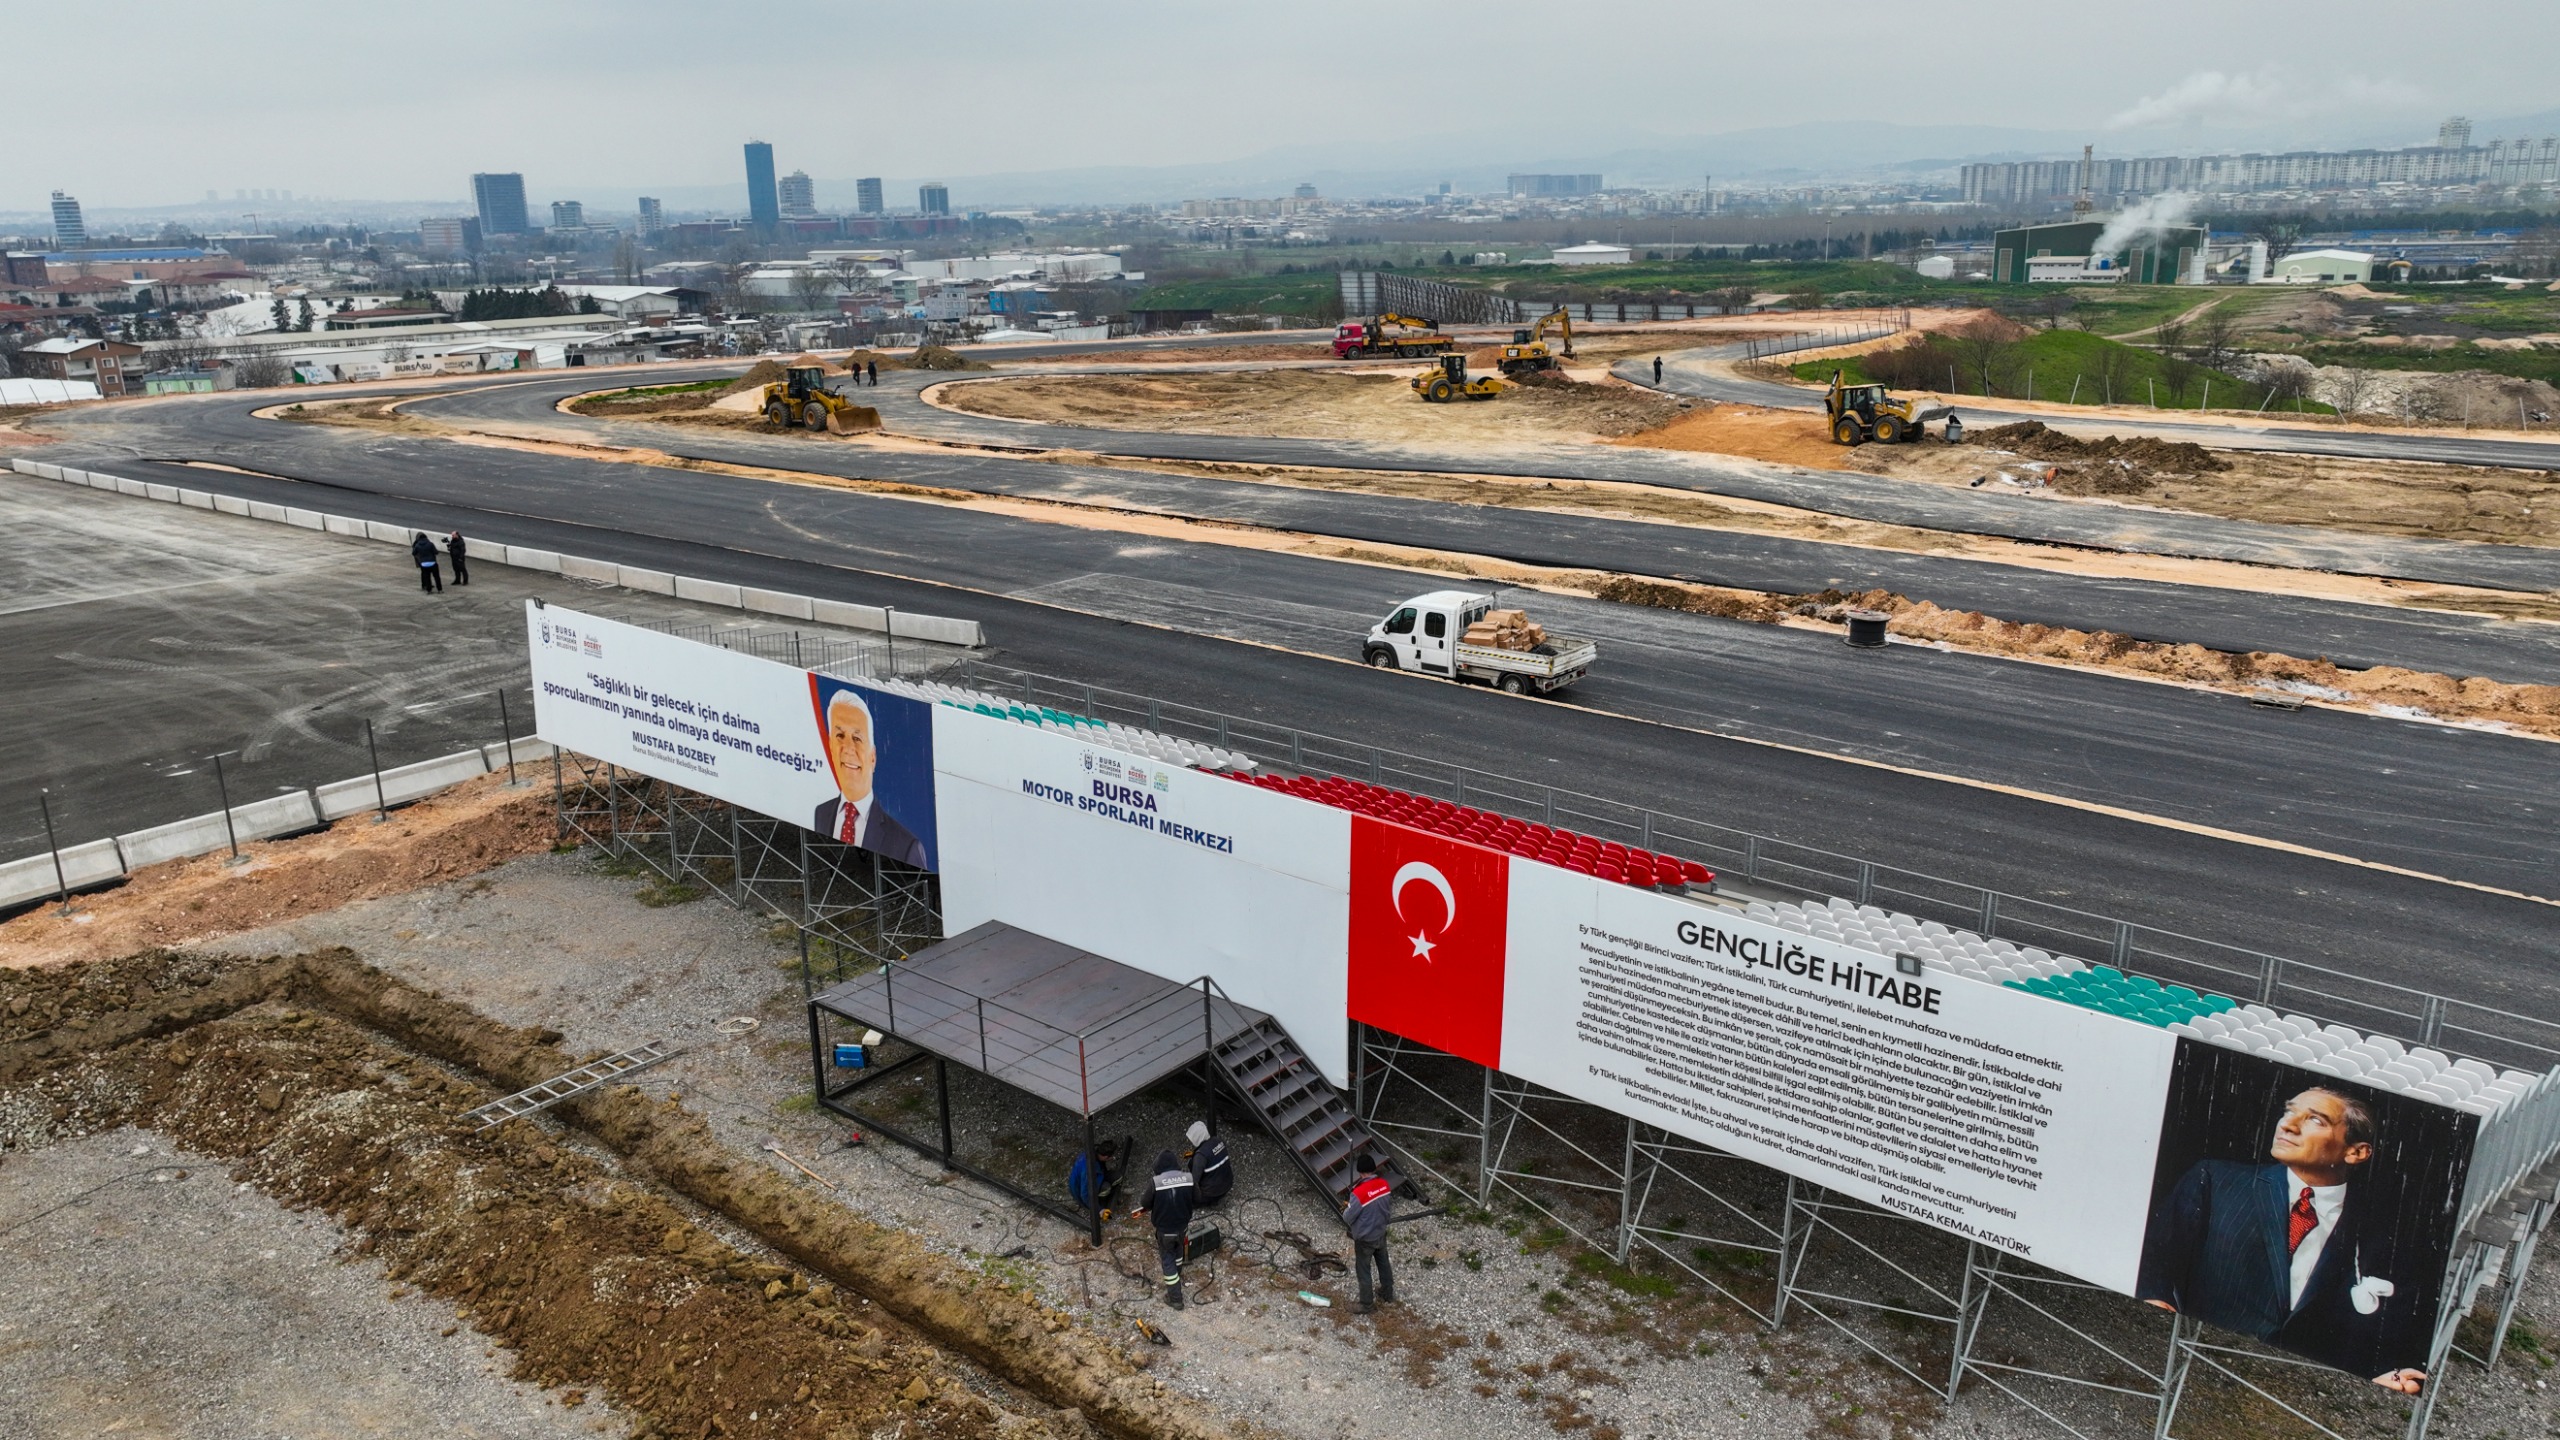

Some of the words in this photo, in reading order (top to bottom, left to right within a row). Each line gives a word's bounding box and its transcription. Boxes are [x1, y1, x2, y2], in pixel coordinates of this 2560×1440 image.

[1507, 349, 1518, 357] CAT
[555, 625, 577, 638] BURSA
[543, 681, 620, 714] sporcularımızın
[622, 705, 665, 727] yanında
[668, 717, 709, 741] olmaya
[712, 729, 753, 753] devam
[756, 744, 823, 773] edeceğiz.”
[587, 672, 631, 697] “Sağlıklı
[633, 685, 648, 702] bir
[651, 694, 695, 716] gelecek
[698, 702, 719, 723] için
[722, 711, 760, 735] daima
[632, 731, 675, 754] MUSTAFA
[677, 745, 716, 766] BOZBEY
[1093, 779, 1158, 813] BURSA
[1099, 757, 1121, 768] BURSA
[1023, 779, 1074, 807] MOTOR
[1078, 796, 1154, 831] SPORLARI
[1160, 819, 1232, 854] MERKEZİ
[1579, 924, 1589, 935] Ey
[1590, 927, 1607, 939] Türk
[1608, 934, 1643, 950] gençliği!
[1644, 943, 1670, 957] Birinci
[1705, 960, 1724, 974] Türk
[1725, 966, 1766, 987] istiklalini,
[1768, 978, 1788, 992] Türk
[1856, 1004, 1894, 1023] ilelebet
[1894, 1017, 1948, 1039] muhafaza
[1949, 1033, 1962, 1043] ve
[1963, 1037, 2014, 1058] müdafaa
[2015, 1052, 2064, 1072] etmektir.
[1677, 921, 1825, 983] GENÇLİĞE
[1831, 962, 1942, 1015] HİTABE
[1579, 966, 1626, 986] cumhuriyeti
[1627, 981, 1667, 998] müdafaa
[1667, 993, 1730, 1018] mecburiyetine
[1731, 1012, 1774, 1032] düşersen,
[1775, 1026, 1814, 1044] vazifeye
[1815, 1039, 1852, 1056] atılmak
[1854, 1048, 1871, 1061] için
[1872, 1054, 1903, 1071] içinde
[1903, 1064, 1968, 1091] bulunacağın
[1969, 1085, 2017, 1106] vaziyetin
[1580, 977, 1590, 986] ve
[1591, 981, 1623, 996] şeraitini
[1623, 990, 1701, 1021] düşünmeyeceksin.
[1702, 1014, 1714, 1024] Bu
[1743, 1028, 1755, 1037] ve
[1756, 1032, 1783, 1047] şerait,
[1784, 1041, 1802, 1052] çok
[1849, 1059, 1863, 1071] bir
[1863, 1066, 1915, 1087] mahiyette
[1916, 1081, 1955, 1100] tezahür
[1956, 1095, 1997, 1113] edebilir.
[1999, 1104, 2033, 1124] İstiklal
[2034, 1118, 2048, 1128] ve
[1581, 942, 1643, 967] Mevcudiyetinin
[1643, 962, 1654, 971] ve
[1654, 964, 1700, 985] istikbalinin
[1736, 989, 1765, 1004] temeli
[1765, 997, 1795, 1014] budur.
[1796, 1006, 1809, 1017] Bu
[1810, 1011, 1840, 1028] temel,
[1841, 1021, 1867, 1035] senin
[1868, 1030, 1881, 1039] en
[1882, 1031, 1923, 1051] kıymetli
[1923, 1043, 1981, 1069] hazinendir.
[1982, 1059, 2036, 1084] İstikbalde
[2036, 1078, 2062, 1092] dahi
[1588, 991, 1646, 1015] cumhuriyetine
[1646, 1008, 1696, 1031] kastedecek
[1697, 1025, 1746, 1048] düşmanlar,
[1747, 1040, 1774, 1056] bütün
[1775, 1050, 1818, 1069] dünyada
[1818, 1064, 1850, 1080] emsali
[1851, 1075, 1910, 1101] görülmemiş
[1911, 1091, 1925, 1103] bir
[1926, 1098, 1980, 1121] galibiyetin
[1981, 1115, 2035, 1137] mümessili
[1589, 957, 1606, 968] seni
[1606, 961, 1618, 971] bu
[1618, 965, 1663, 985] hazineden
[1663, 980, 1701, 997] mahrum
[1702, 992, 1730, 1006] etmek
[1732, 999, 1774, 1019] isteyecek
[1802, 1022, 1814, 1031] ve
[1842, 1032, 1903, 1058] bedhahların
[1904, 1053, 1951, 1073] olacaktır.
[1953, 1065, 1967, 1077] Bir
[1967, 1072, 1991, 1086] gün,
[1992, 1077, 2027, 1095] istiklal
[2028, 1090, 2041, 1100] ve
[1589, 1065, 1599, 1076] Ey
[1600, 1068, 1617, 1081] Türk
[1618, 1075, 1662, 1097] istikbalinin
[1691, 1098, 1709, 1114] İşte,
[1710, 1106, 1722, 1117] bu
[1722, 1113, 1748, 1127] ahval
[1748, 1121, 1760, 1131] ve
[1760, 1126, 1786, 1140] şerait
[1787, 1133, 1815, 1150] içinde
[1815, 1144, 1838, 1158] dahi
[1838, 1153, 1876, 1172] vazifen,
[1878, 1164, 1898, 1179] Türk
[1900, 1172, 1932, 1191] istiklal
[1932, 1185, 1945, 1195] ve
[1946, 1190, 2017, 1220] cumhuriyetini
[1625, 1088, 1679, 1114] kurtarmaktır.
[1681, 1108, 1714, 1128] Muhtaç
[1715, 1122, 1752, 1140] olduğun
[1753, 1133, 1785, 1152] kudret,
[1785, 1146, 1859, 1178] damarlarındaki
[1860, 1173, 1877, 1184] asil
[1877, 1177, 1910, 1195] kanda
[1911, 1190, 1965, 1215] mevcuttur.
[1645, 1067, 1689, 1087] edebilirler.
[1689, 1080, 1715, 1096] Millet,
[1716, 1089, 1771, 1115] fakruzaruret
[1772, 1107, 1800, 1124] içinde
[1801, 1117, 1830, 1135] harap
[1831, 1129, 1843, 1139] ve
[1843, 1132, 1870, 1149] bitap
[1870, 1142, 1909, 1163] düşmüş
[1910, 1156, 1946, 1174] olabilir.
[1881, 1194, 1935, 1222] MUSTAFA
[1936, 1214, 1976, 1236] KEMAL
[1978, 1230, 2031, 1256] ATATÜRK
